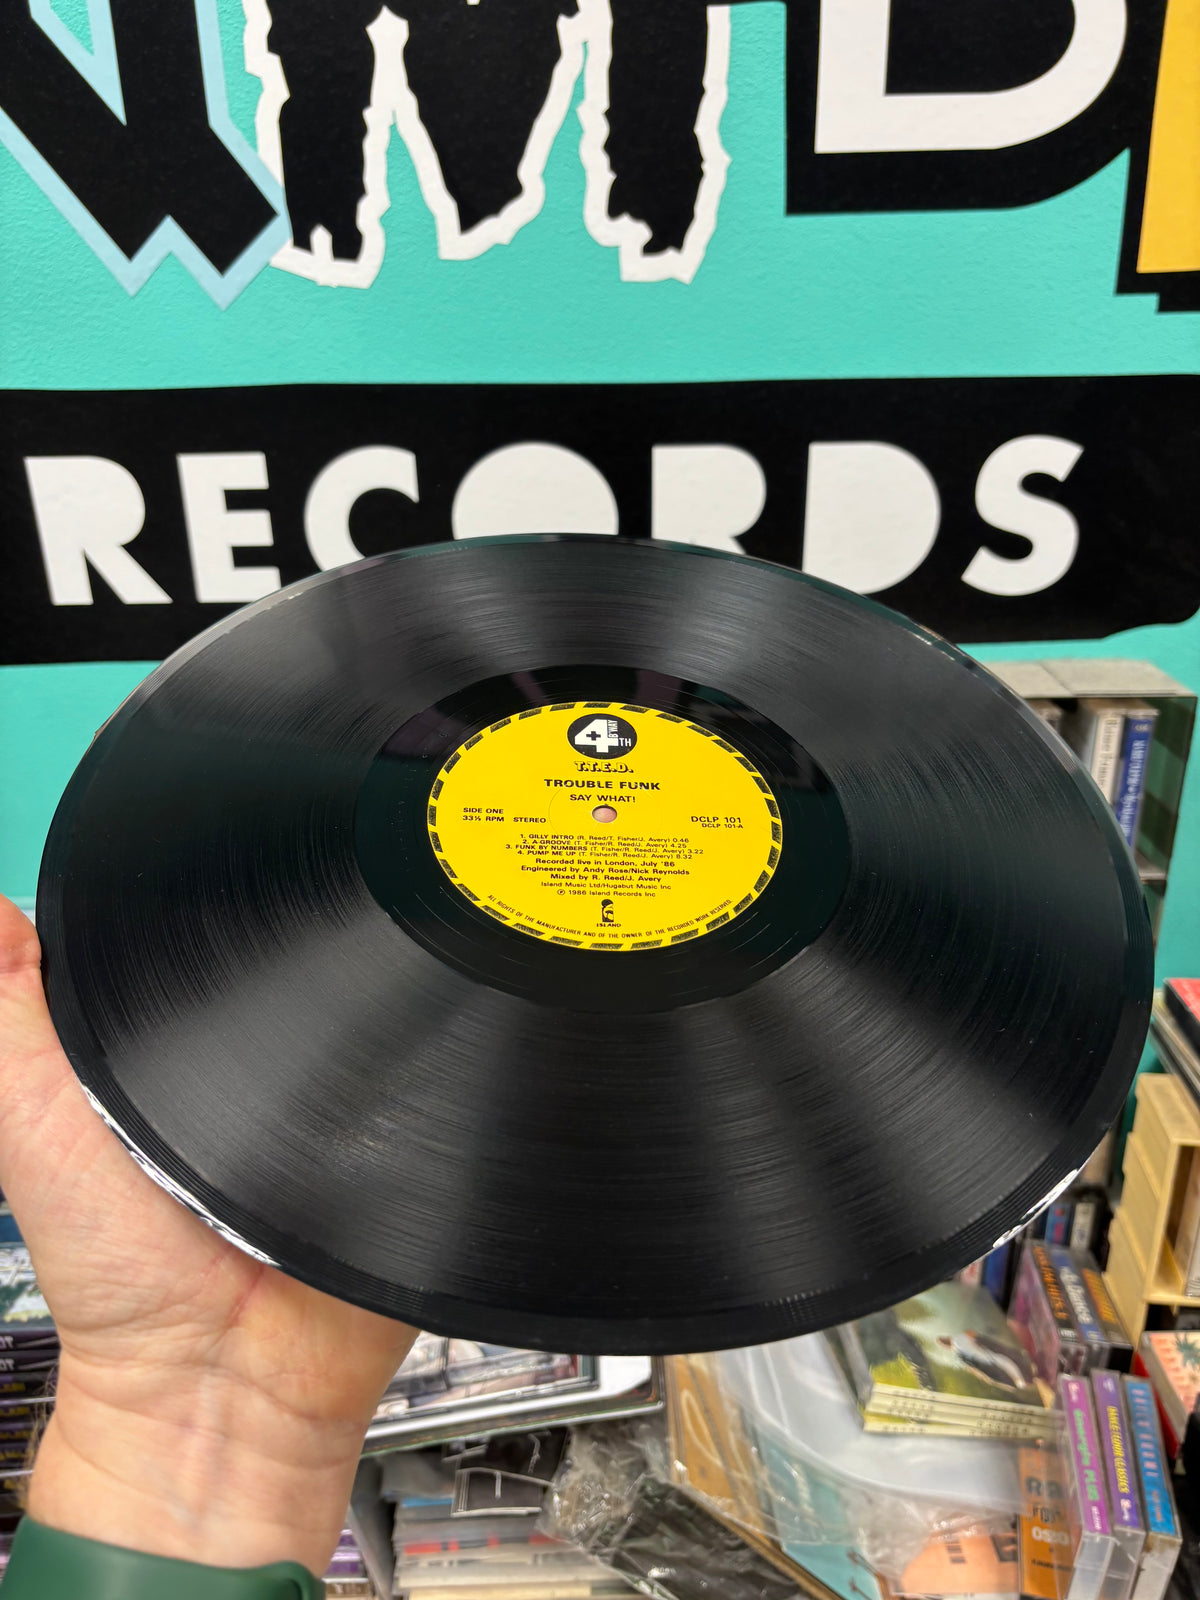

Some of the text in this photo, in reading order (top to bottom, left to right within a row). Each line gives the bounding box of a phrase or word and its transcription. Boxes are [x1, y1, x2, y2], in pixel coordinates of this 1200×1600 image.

[24, 434, 1085, 605] RECORDS
[544, 779, 661, 790] TROUBLE FUNK
[569, 794, 636, 803] SAY WHAT!
[691, 816, 719, 824] DCLP
[488, 894, 496, 902] ALL
[497, 900, 515, 914] RIGHTS
[536, 920, 581, 935] MANUFACTURER
[667, 920, 695, 932] RECORDED
[695, 913, 710, 922] WORK
